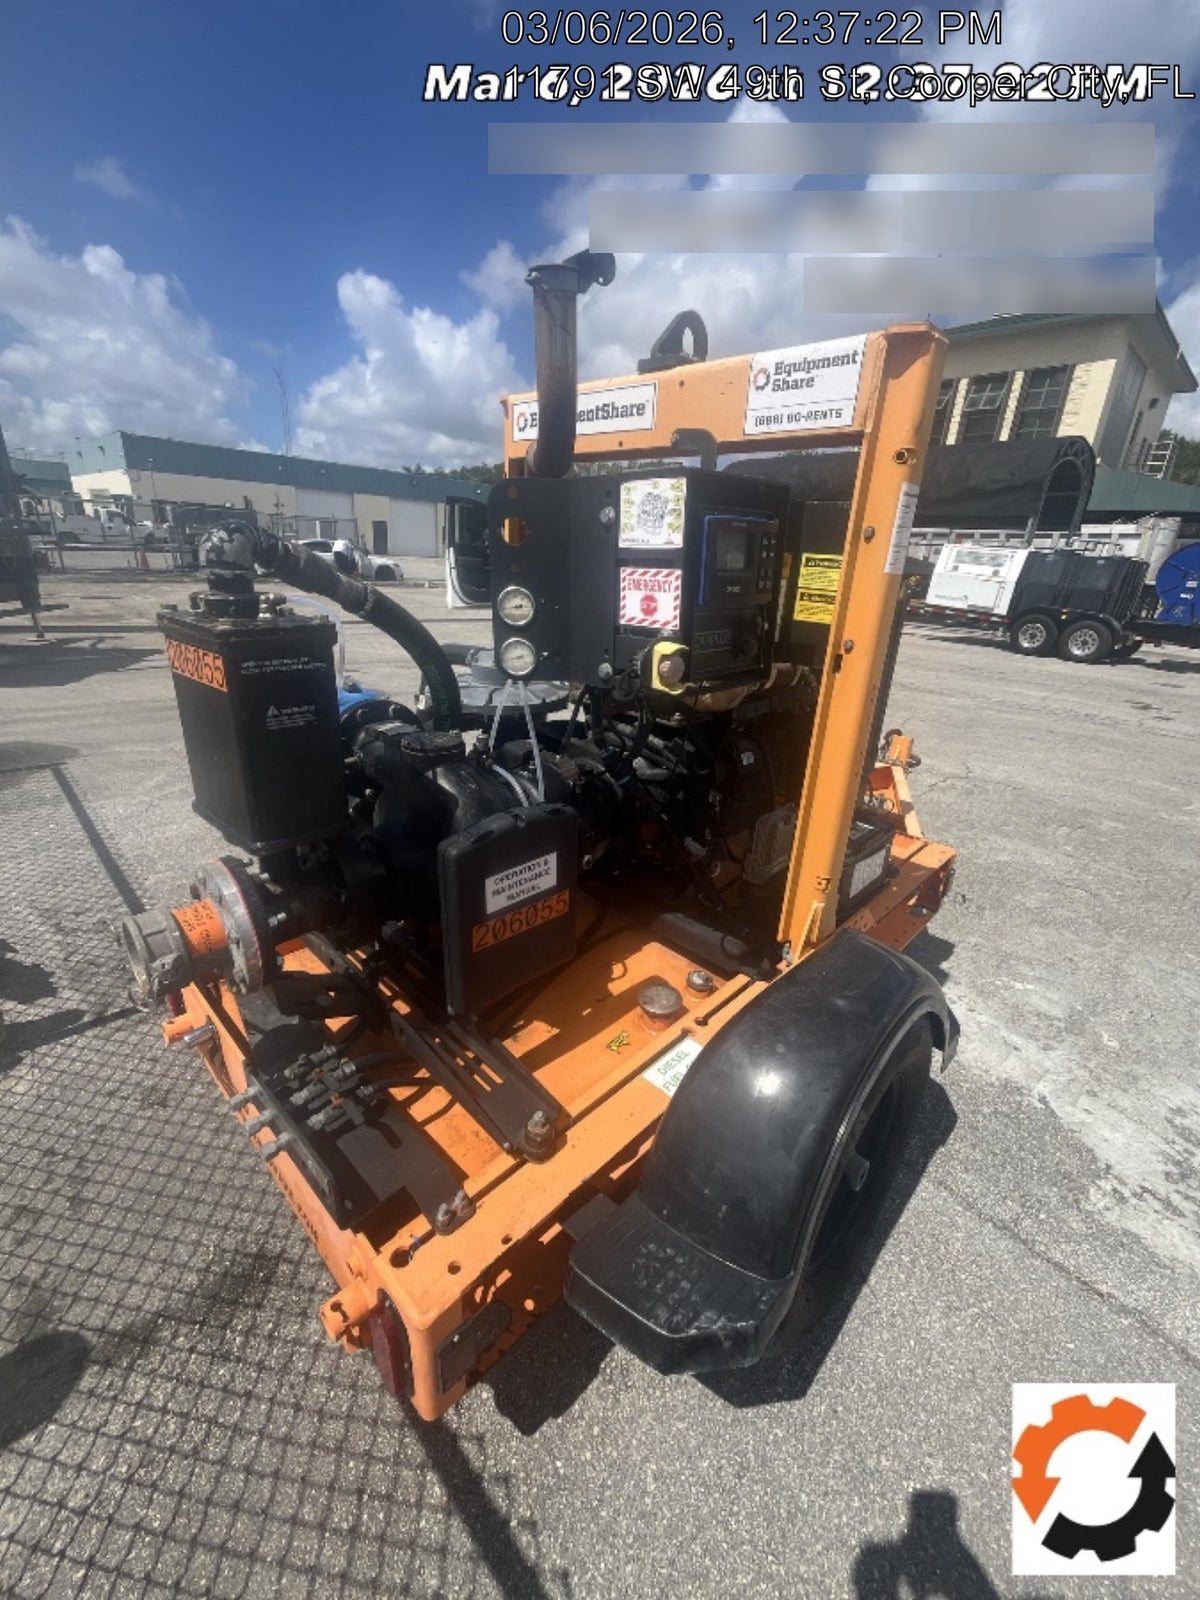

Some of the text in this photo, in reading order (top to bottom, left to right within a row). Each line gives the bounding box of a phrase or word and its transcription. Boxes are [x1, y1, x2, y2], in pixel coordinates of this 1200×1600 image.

[773, 350, 859, 377] Equipment
[771, 376, 815, 392] Share
[529, 402, 646, 428] EentShare
[626, 578, 673, 594] EMERGENCY
[475, 897, 567, 949] 206055
[657, 1050, 690, 1076] DIESEL
